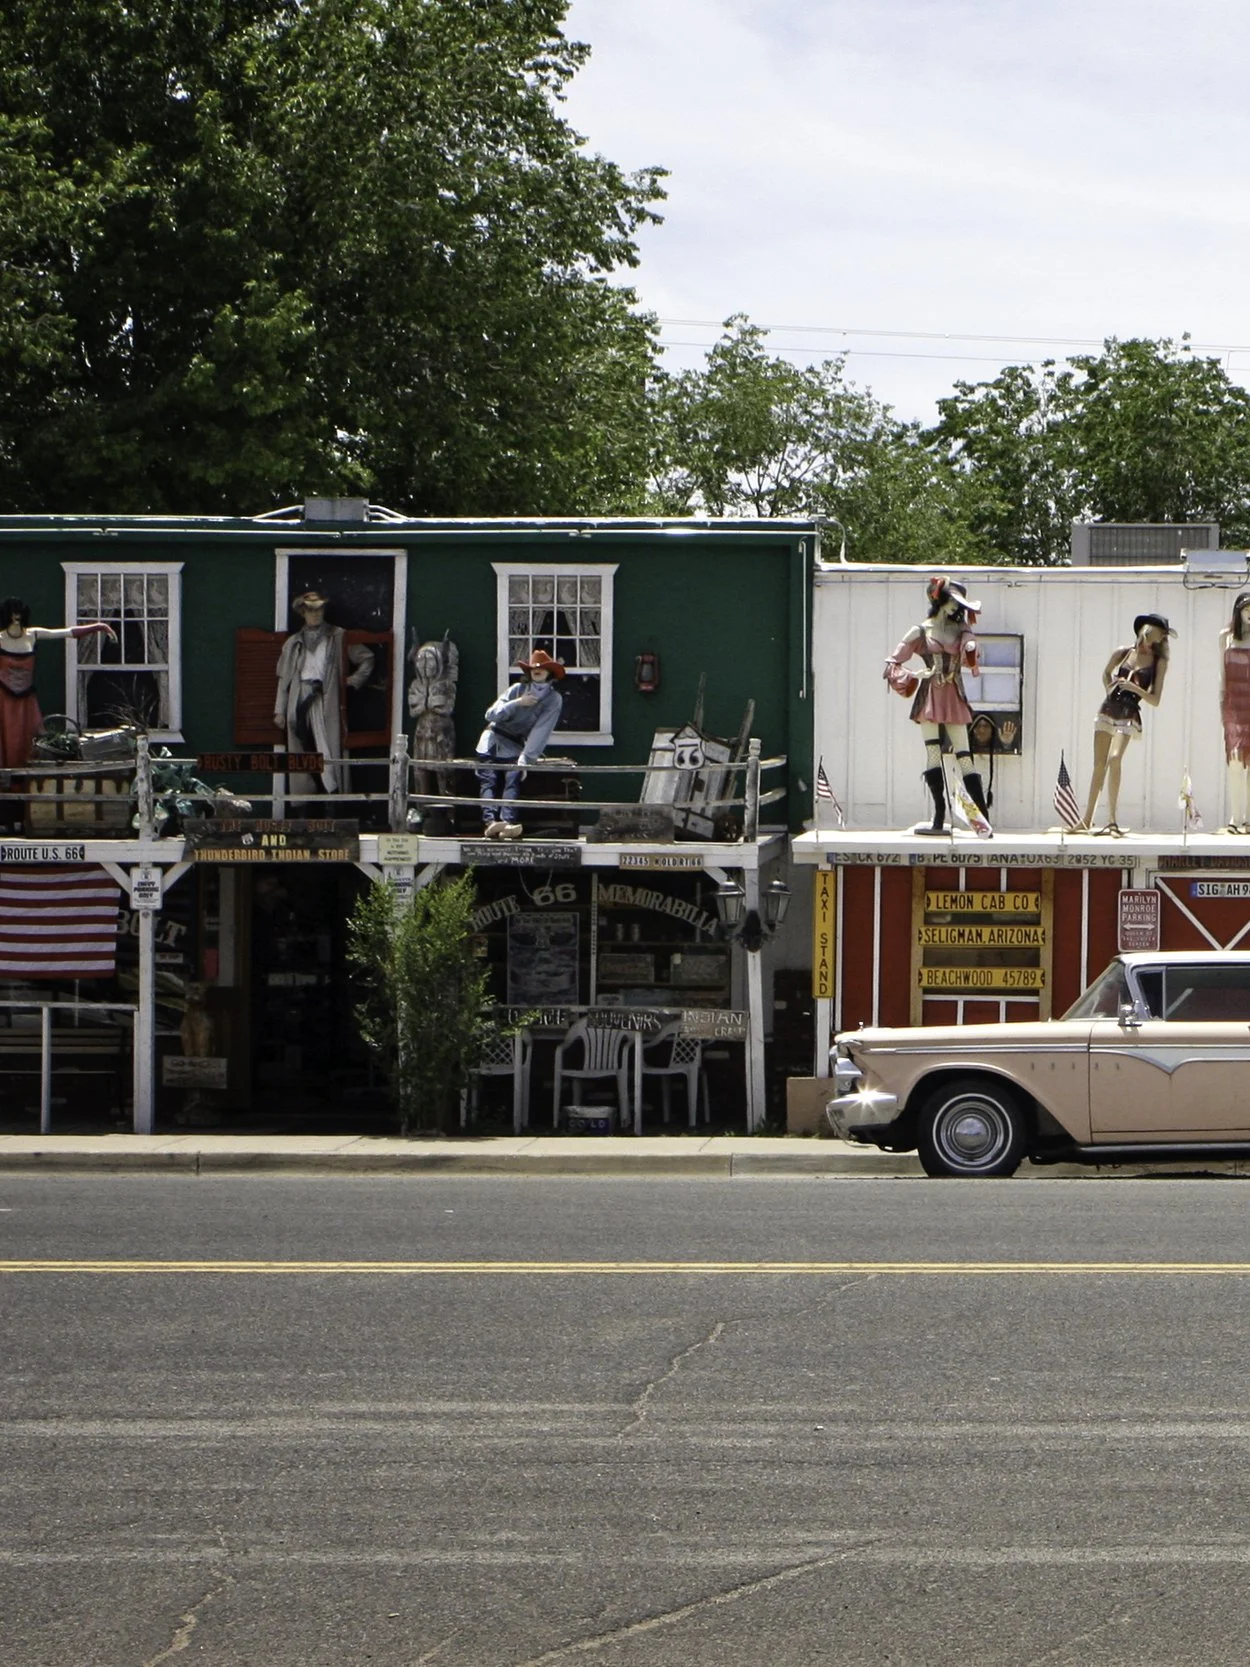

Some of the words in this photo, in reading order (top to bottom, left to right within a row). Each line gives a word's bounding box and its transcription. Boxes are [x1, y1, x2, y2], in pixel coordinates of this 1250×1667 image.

[261, 834, 287, 847] AND
[7, 847, 38, 860] ROUTE
[41, 847, 62, 860] U.S.
[65, 847, 78, 860] 66
[194, 849, 266, 861] THUNDERBIRD
[271, 849, 311, 861] INDIAN
[318, 849, 349, 861] STORE
[990, 854, 1019, 864] ANA
[532, 883, 577, 906] 66
[1198, 883, 1219, 896] SIG
[1226, 883, 1240, 896] AH
[820, 873, 830, 922] TAXI
[935, 894, 974, 910] LEMON
[981, 894, 1006, 910] CAB
[1013, 894, 1029, 910] CO
[1122, 895, 1157, 904] MARILYN
[598, 883, 718, 937] MEMORABILIA
[1122, 904, 1157, 913] MONROE
[1122, 912, 1157, 922] PARKING
[988, 928, 1040, 944] ARIZONA
[819, 933, 829, 994] STAND
[927, 969, 993, 986] BEACHWOOD
[1002, 970, 1037, 986] 45789
[683, 1010, 742, 1025] INDIAN
